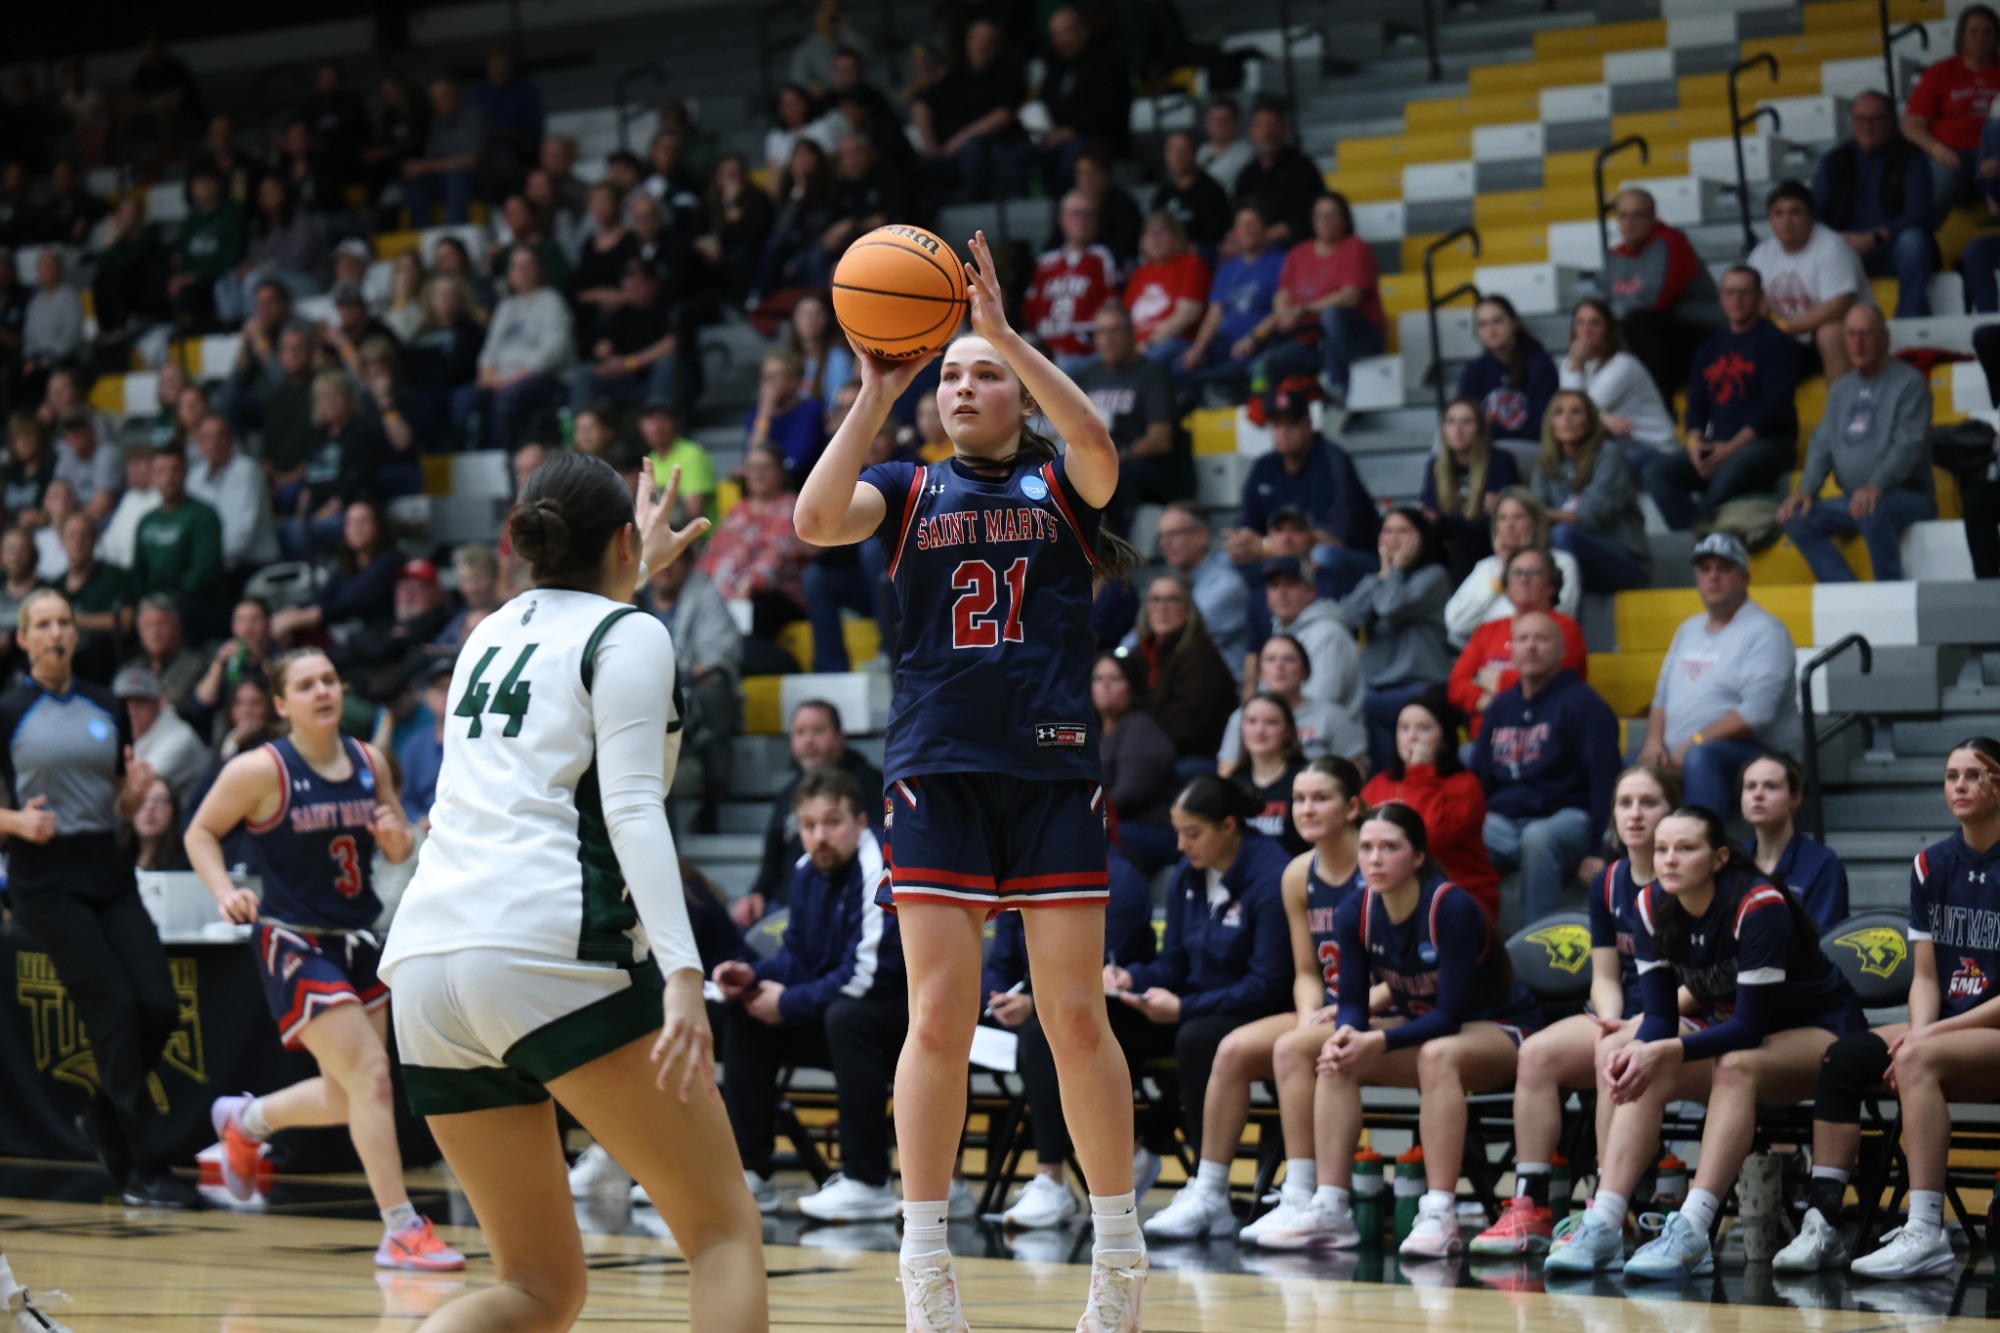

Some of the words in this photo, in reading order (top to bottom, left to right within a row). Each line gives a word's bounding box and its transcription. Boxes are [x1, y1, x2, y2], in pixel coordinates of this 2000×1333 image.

[917, 510, 979, 551] SAINT
[984, 507, 1059, 546] MARY'S
[951, 556, 1029, 650] 21
[453, 642, 540, 739] 44
[290, 802, 337, 833] SAINT
[329, 833, 363, 899] 3
